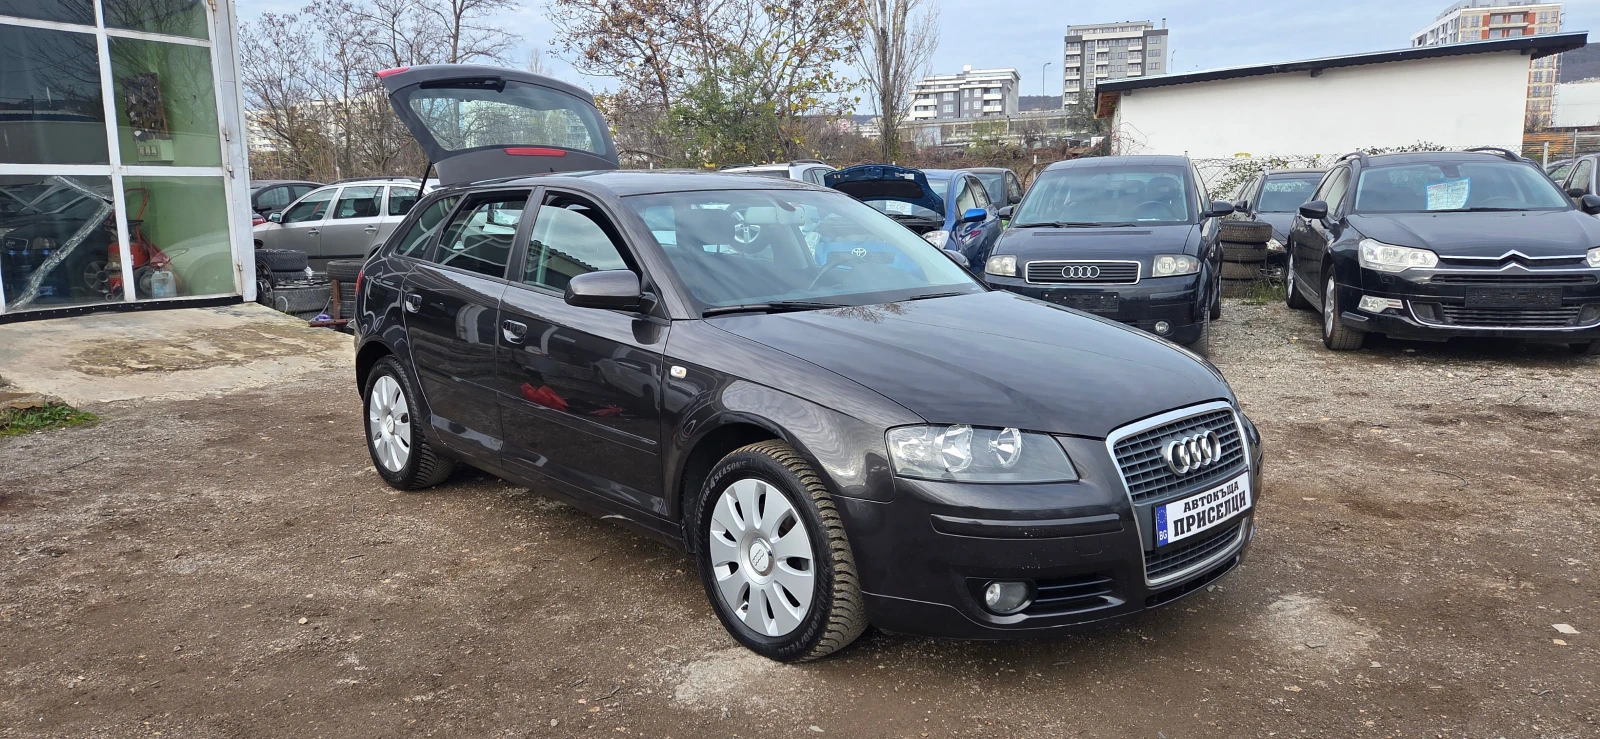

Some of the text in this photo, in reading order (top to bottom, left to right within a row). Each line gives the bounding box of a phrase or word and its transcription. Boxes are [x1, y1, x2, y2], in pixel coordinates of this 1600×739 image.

[1183, 480, 1239, 513] АВТОКЪЩА
[1173, 490, 1246, 537] ПРИСЕЛЦИ
[1159, 530, 1168, 541] BG
